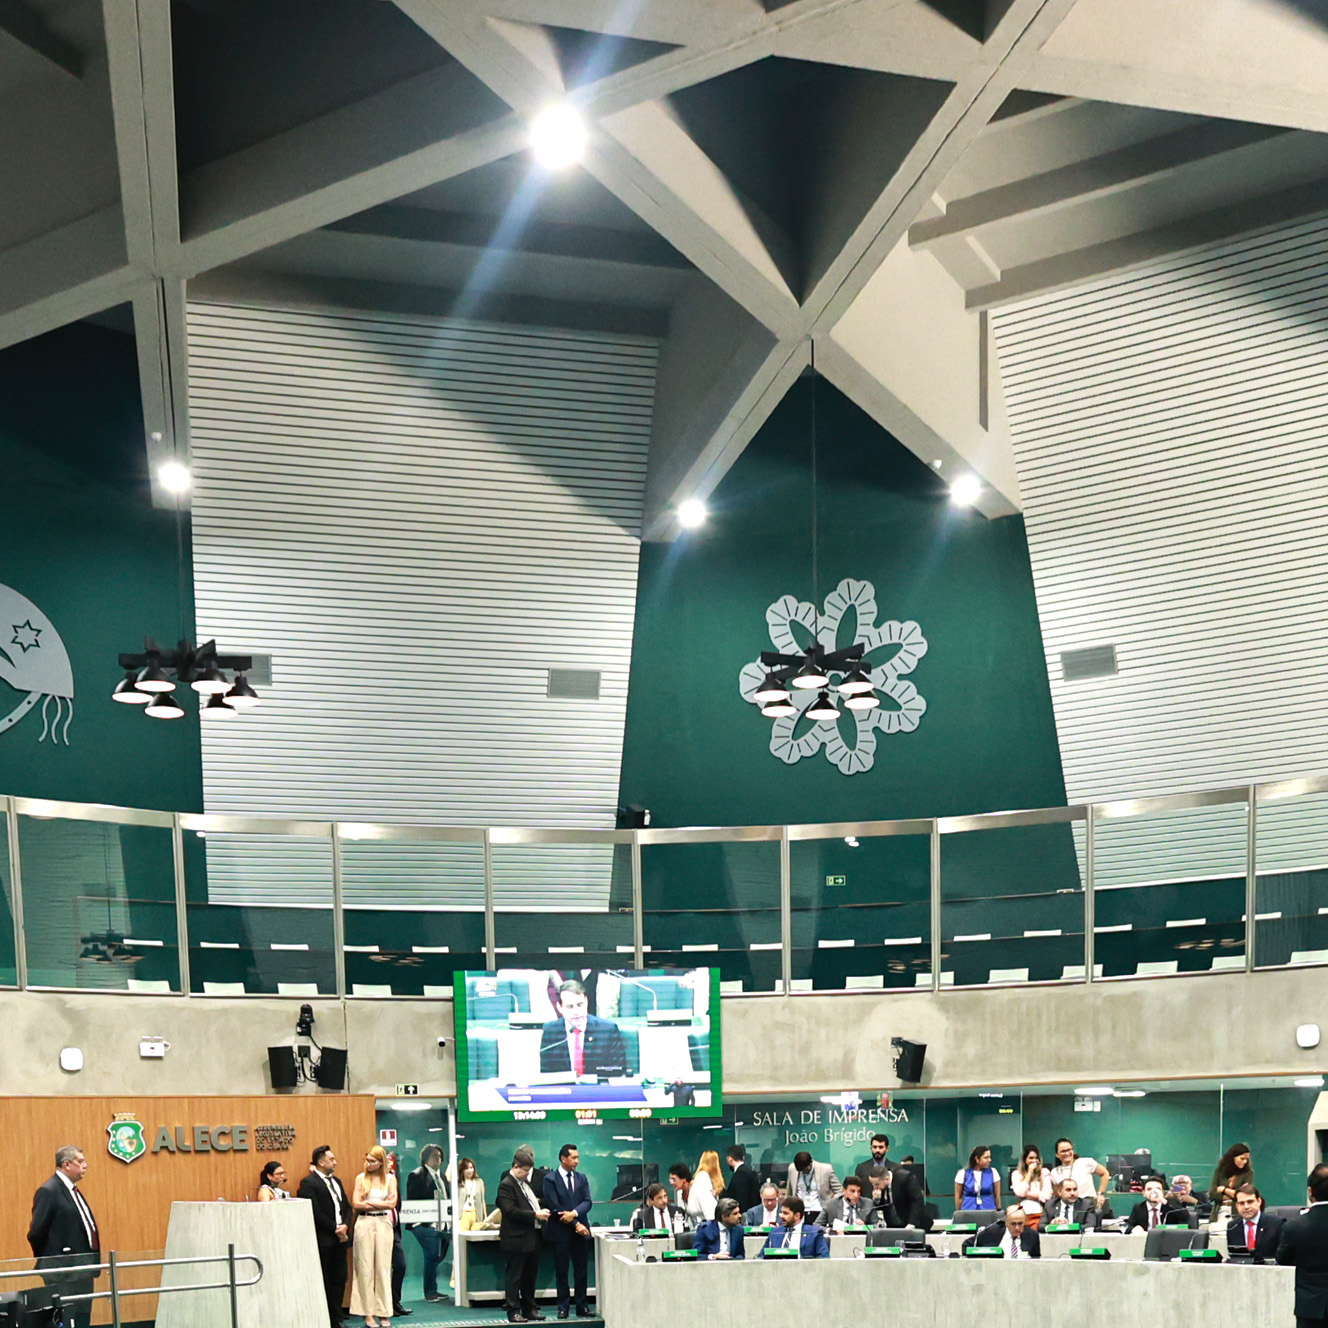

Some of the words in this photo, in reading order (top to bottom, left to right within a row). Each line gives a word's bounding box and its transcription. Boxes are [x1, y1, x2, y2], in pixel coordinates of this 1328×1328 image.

[753, 1110, 794, 1126] SALA
[800, 1110, 822, 1125] DE
[828, 1108, 909, 1124] IMPRENSA
[152, 1125, 249, 1154] ALECE
[784, 1128, 818, 1147] João
[824, 1125, 876, 1147] Brígido
